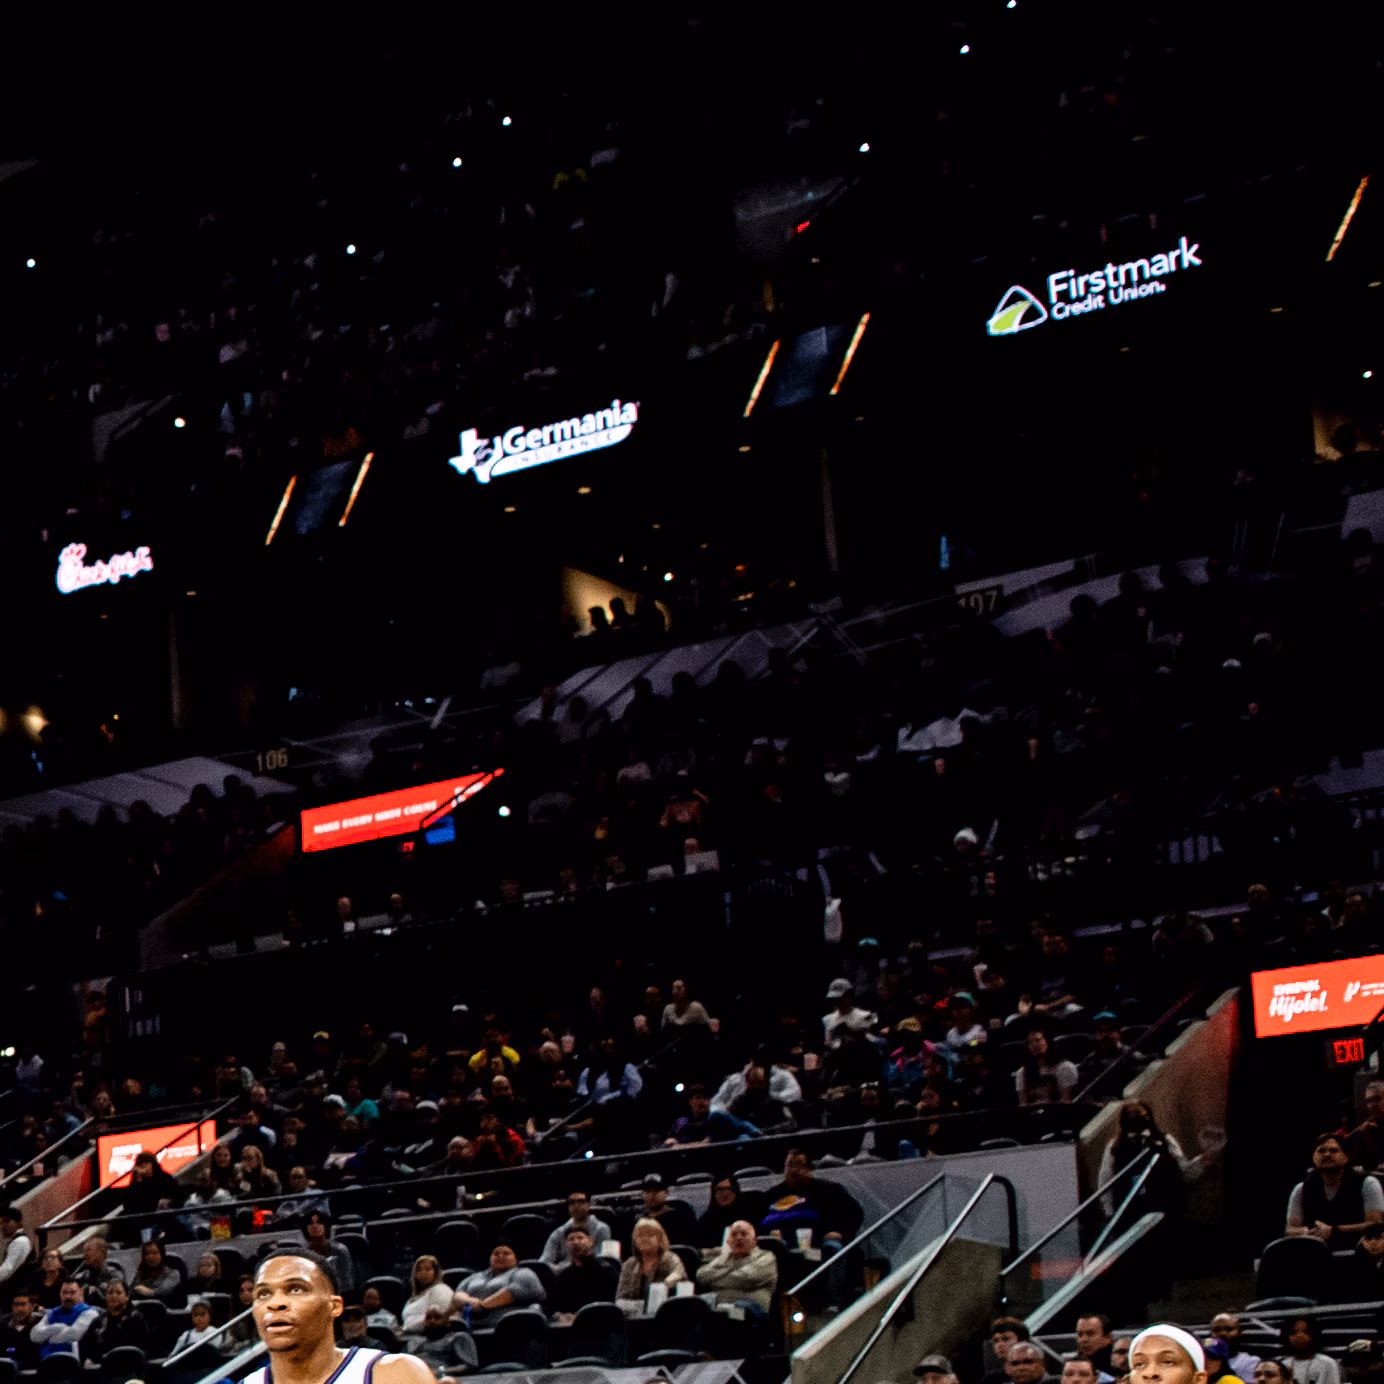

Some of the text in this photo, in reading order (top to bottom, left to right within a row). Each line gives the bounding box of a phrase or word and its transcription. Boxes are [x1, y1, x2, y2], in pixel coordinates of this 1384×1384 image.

[1047, 236, 1202, 304] Firstmark
[1051, 293, 1105, 320] Credit
[503, 398, 638, 455] Germania
[256, 748, 288, 772] 106
